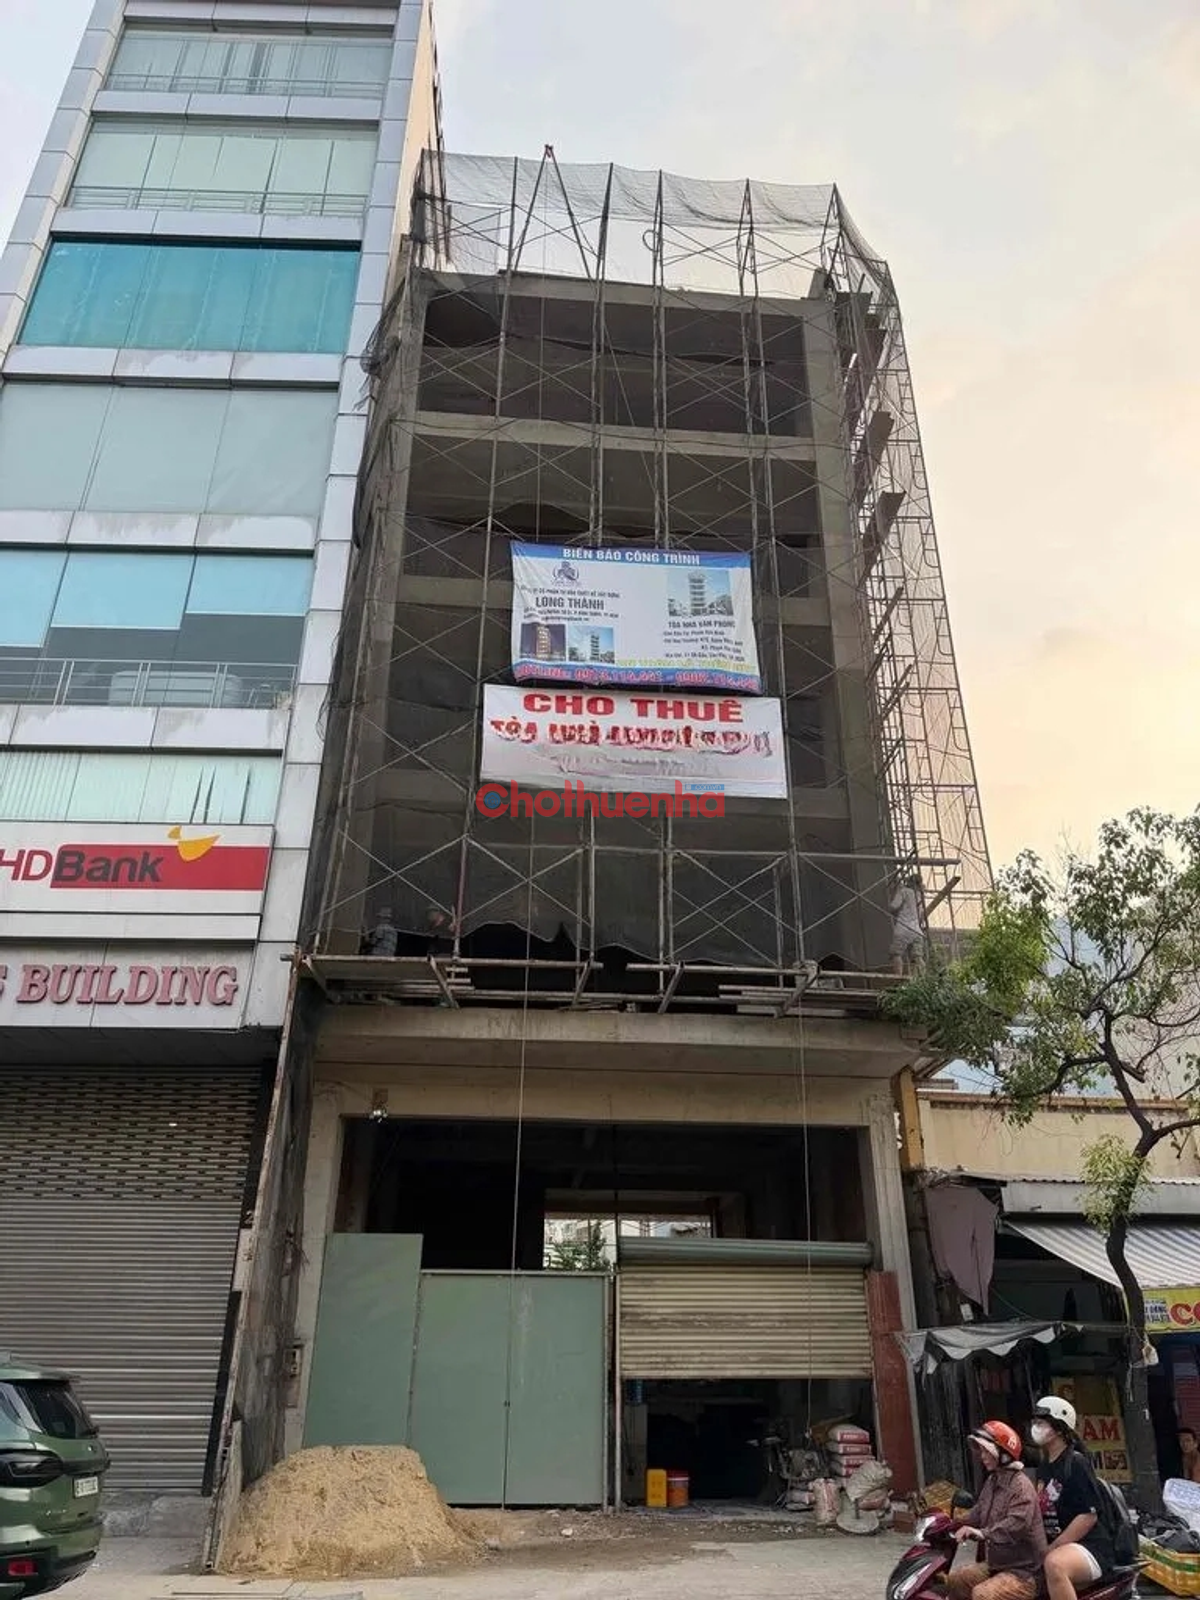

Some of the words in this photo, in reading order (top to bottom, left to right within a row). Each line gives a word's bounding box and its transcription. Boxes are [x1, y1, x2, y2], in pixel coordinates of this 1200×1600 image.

[523, 693, 615, 716] CHO
[630, 698, 743, 723] THUÊ
[0, 849, 163, 882] HDBank
[16, 964, 239, 1007] BUILDING
